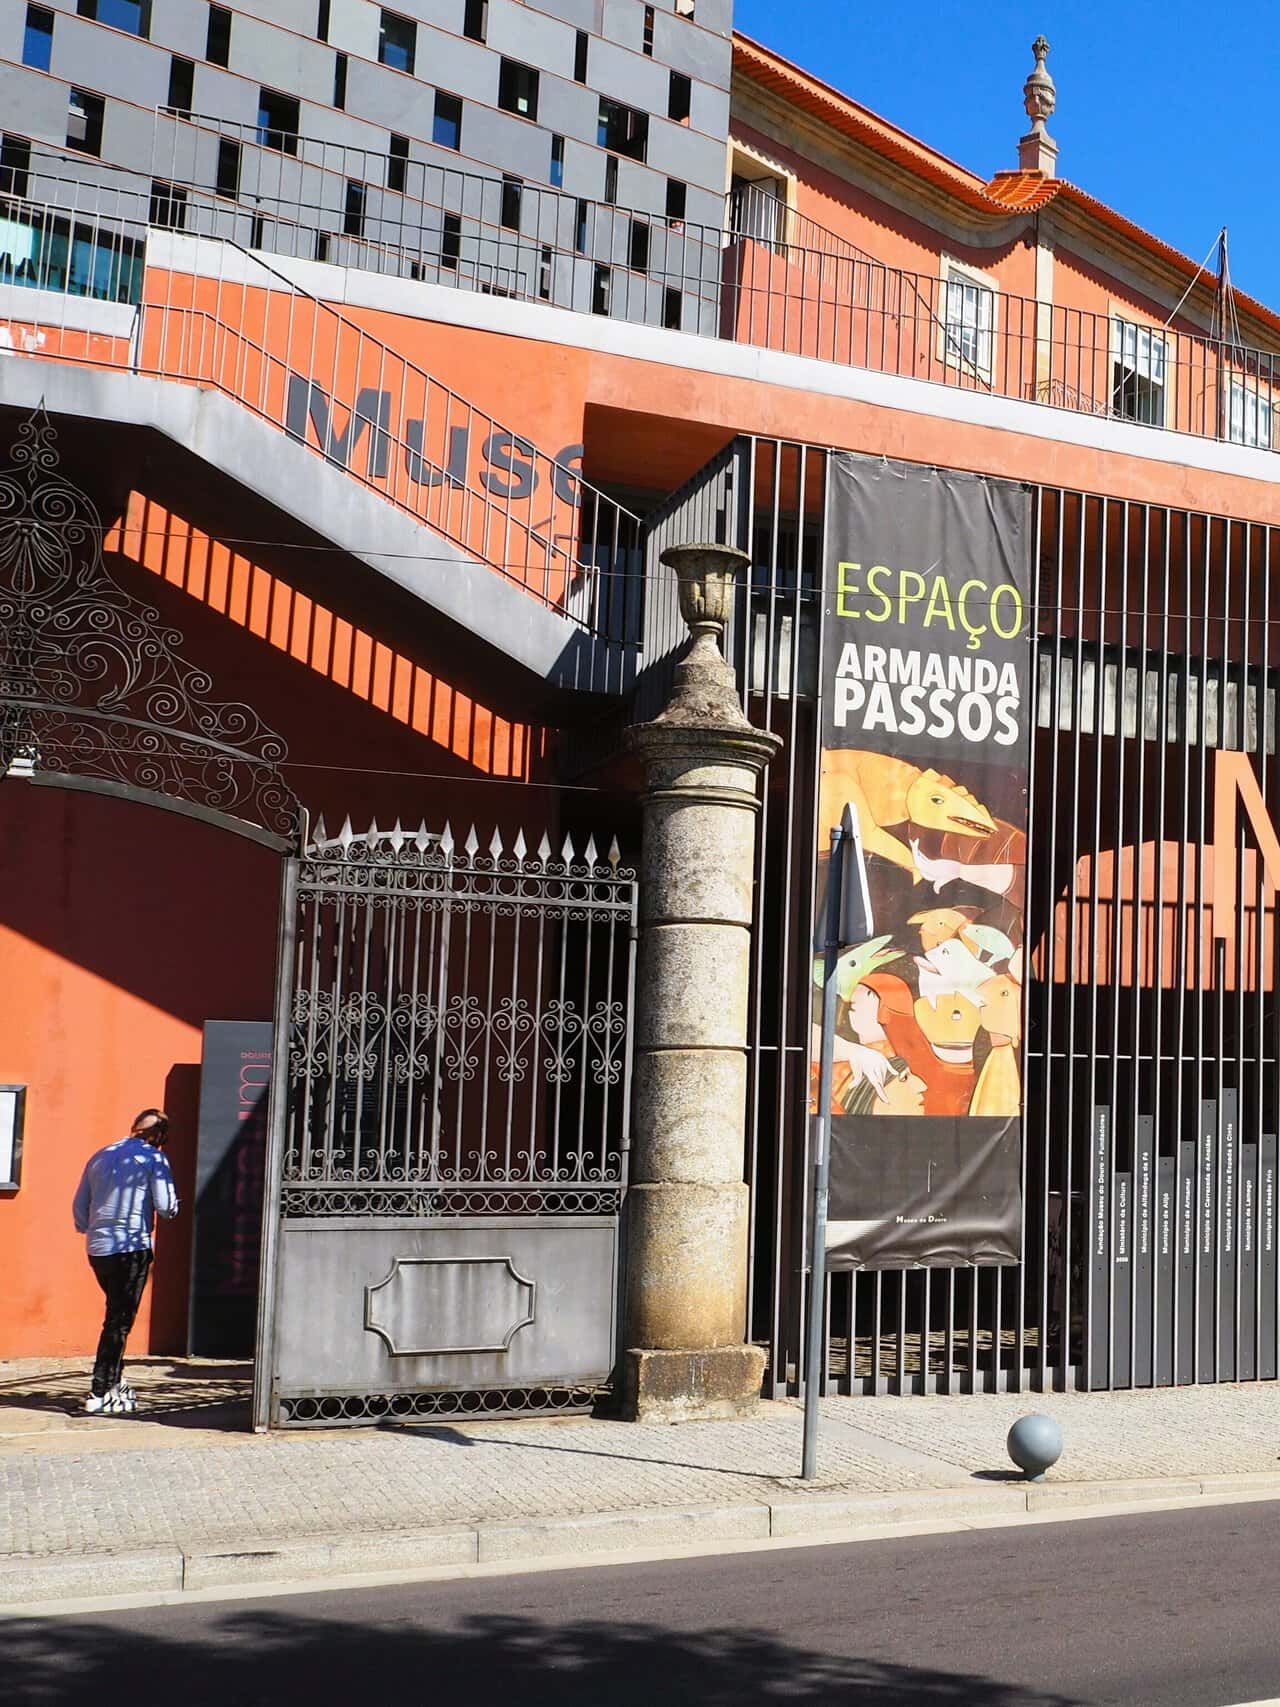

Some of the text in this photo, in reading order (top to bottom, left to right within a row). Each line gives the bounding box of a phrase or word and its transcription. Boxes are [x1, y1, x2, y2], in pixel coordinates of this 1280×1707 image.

[836, 561, 1023, 650] ESPAÇO
[835, 642, 1021, 699] ARMANDA
[833, 676, 1021, 746] PASSOS
